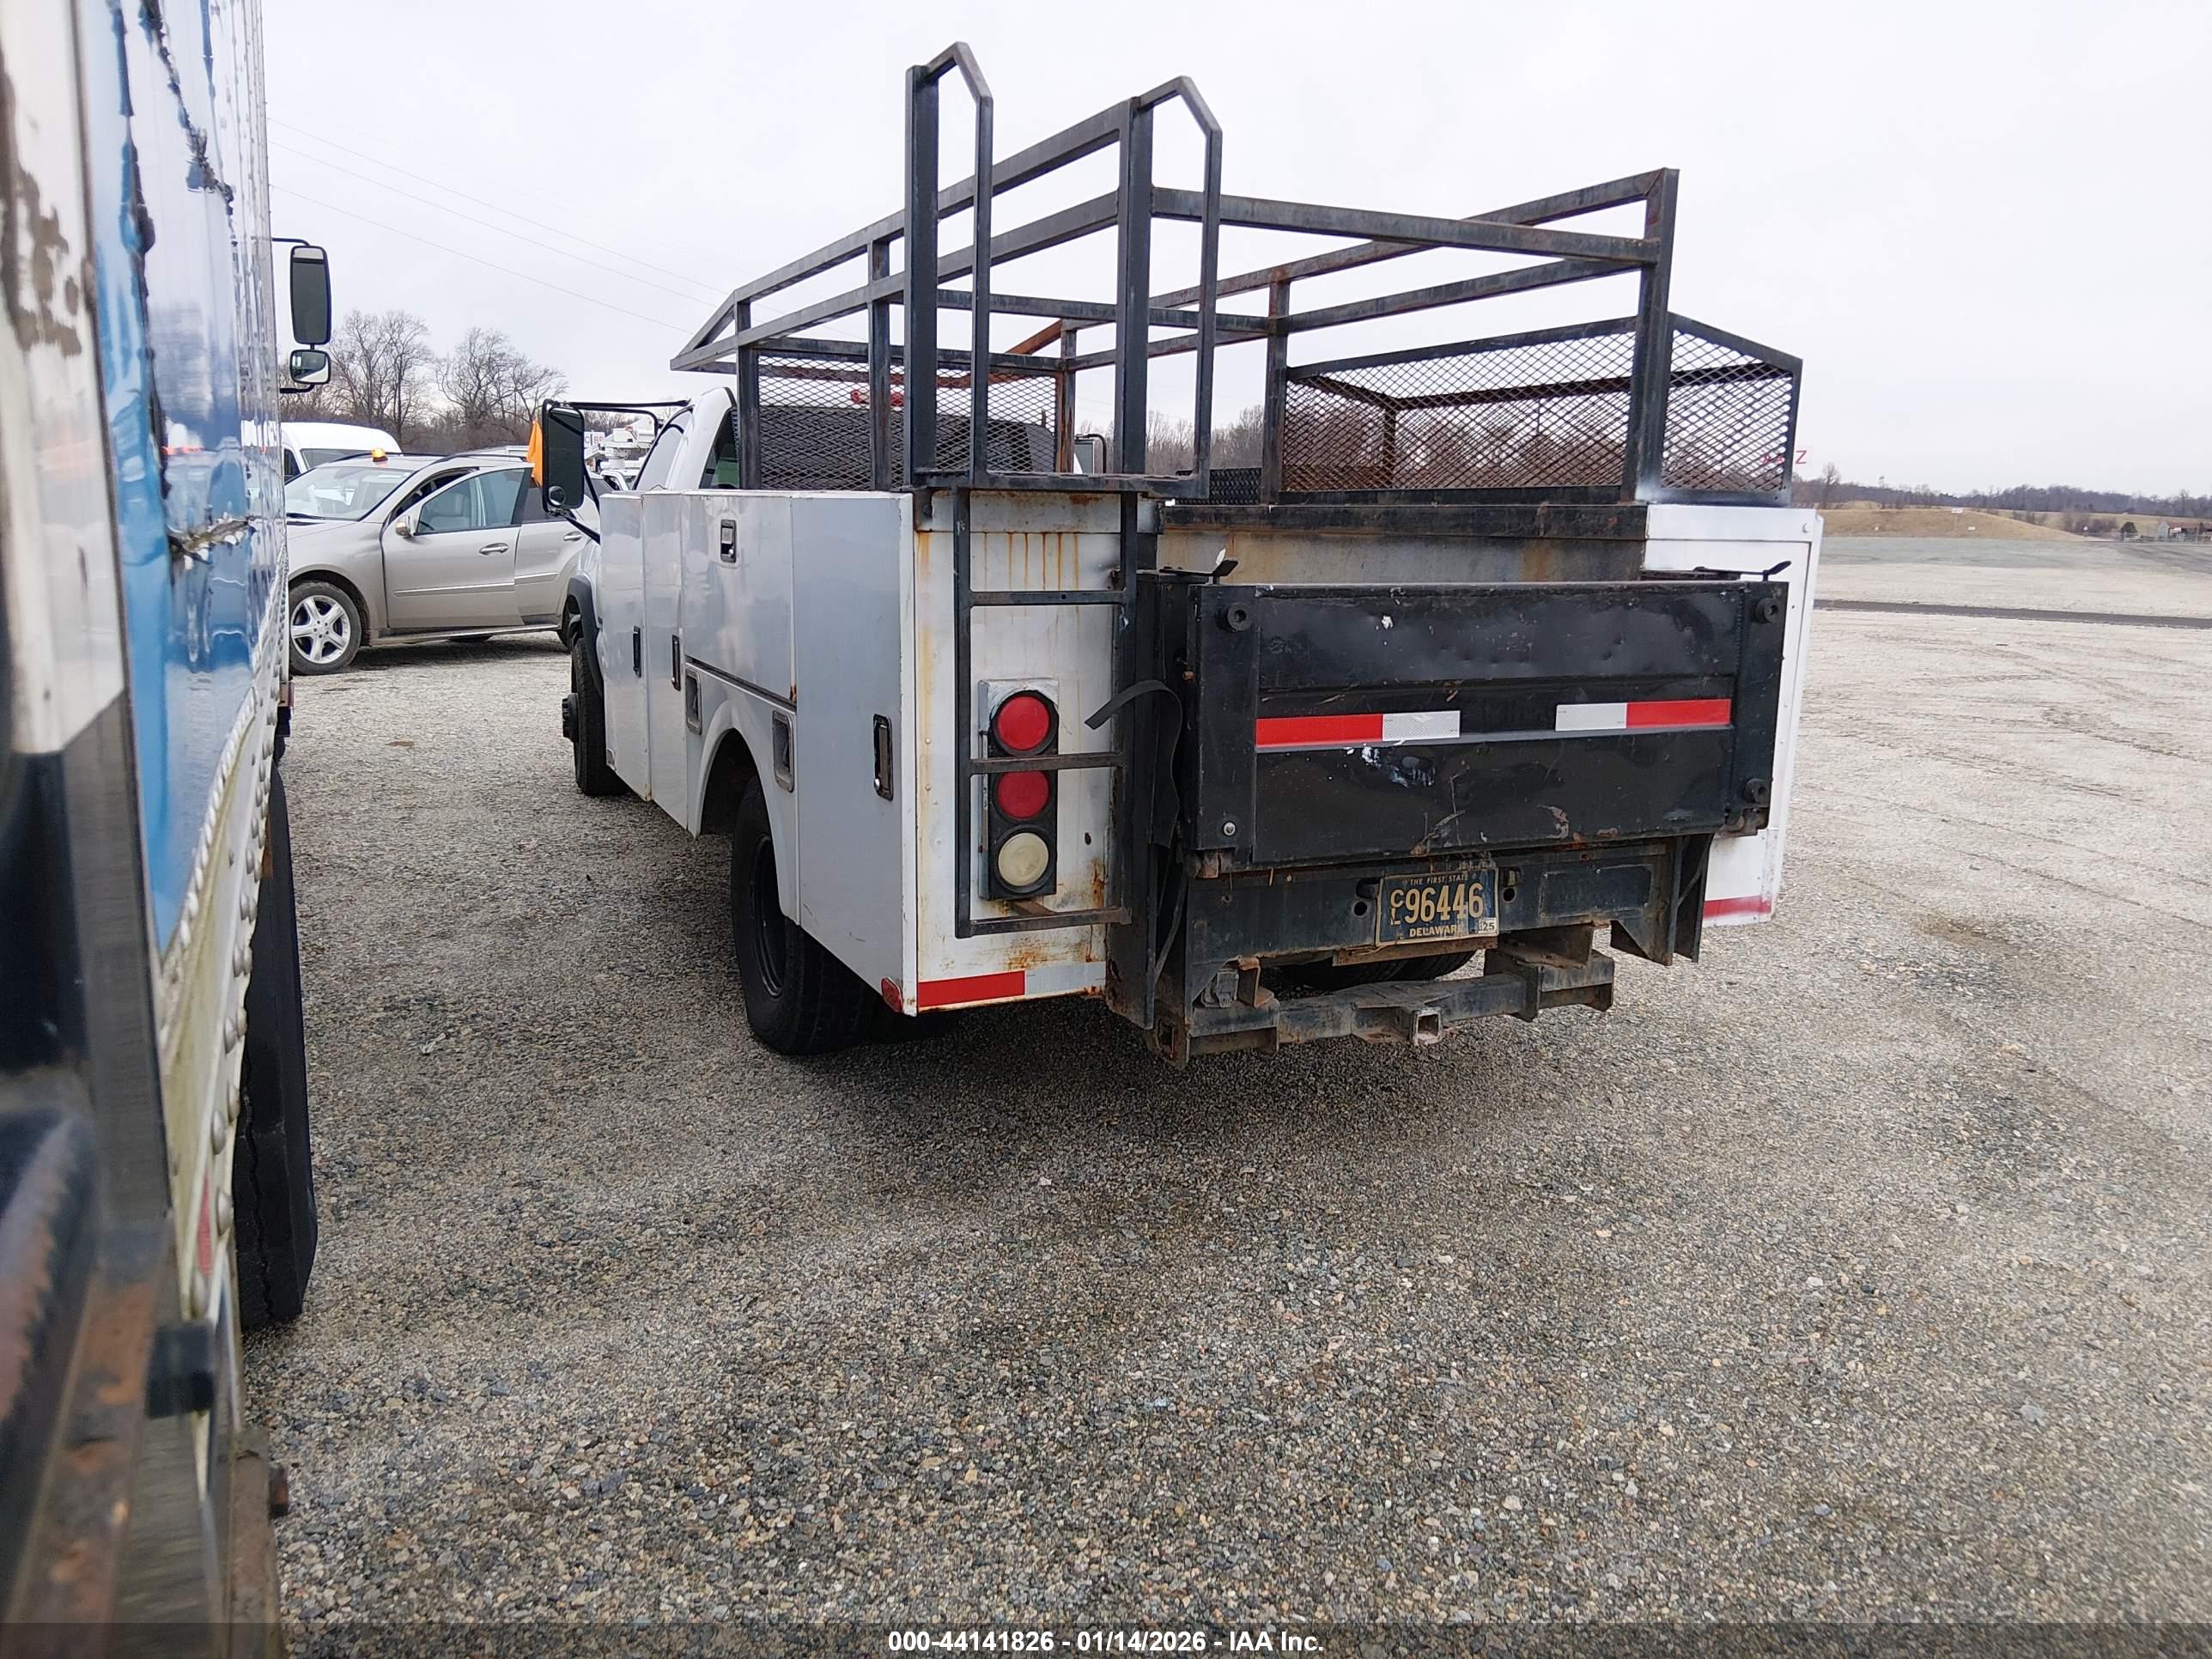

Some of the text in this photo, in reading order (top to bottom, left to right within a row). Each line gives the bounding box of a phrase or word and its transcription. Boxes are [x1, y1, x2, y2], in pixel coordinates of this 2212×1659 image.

[1426, 876, 1446, 884] FIRST
[1449, 872, 1468, 883] STATE
[1483, 921, 1495, 931] 25
